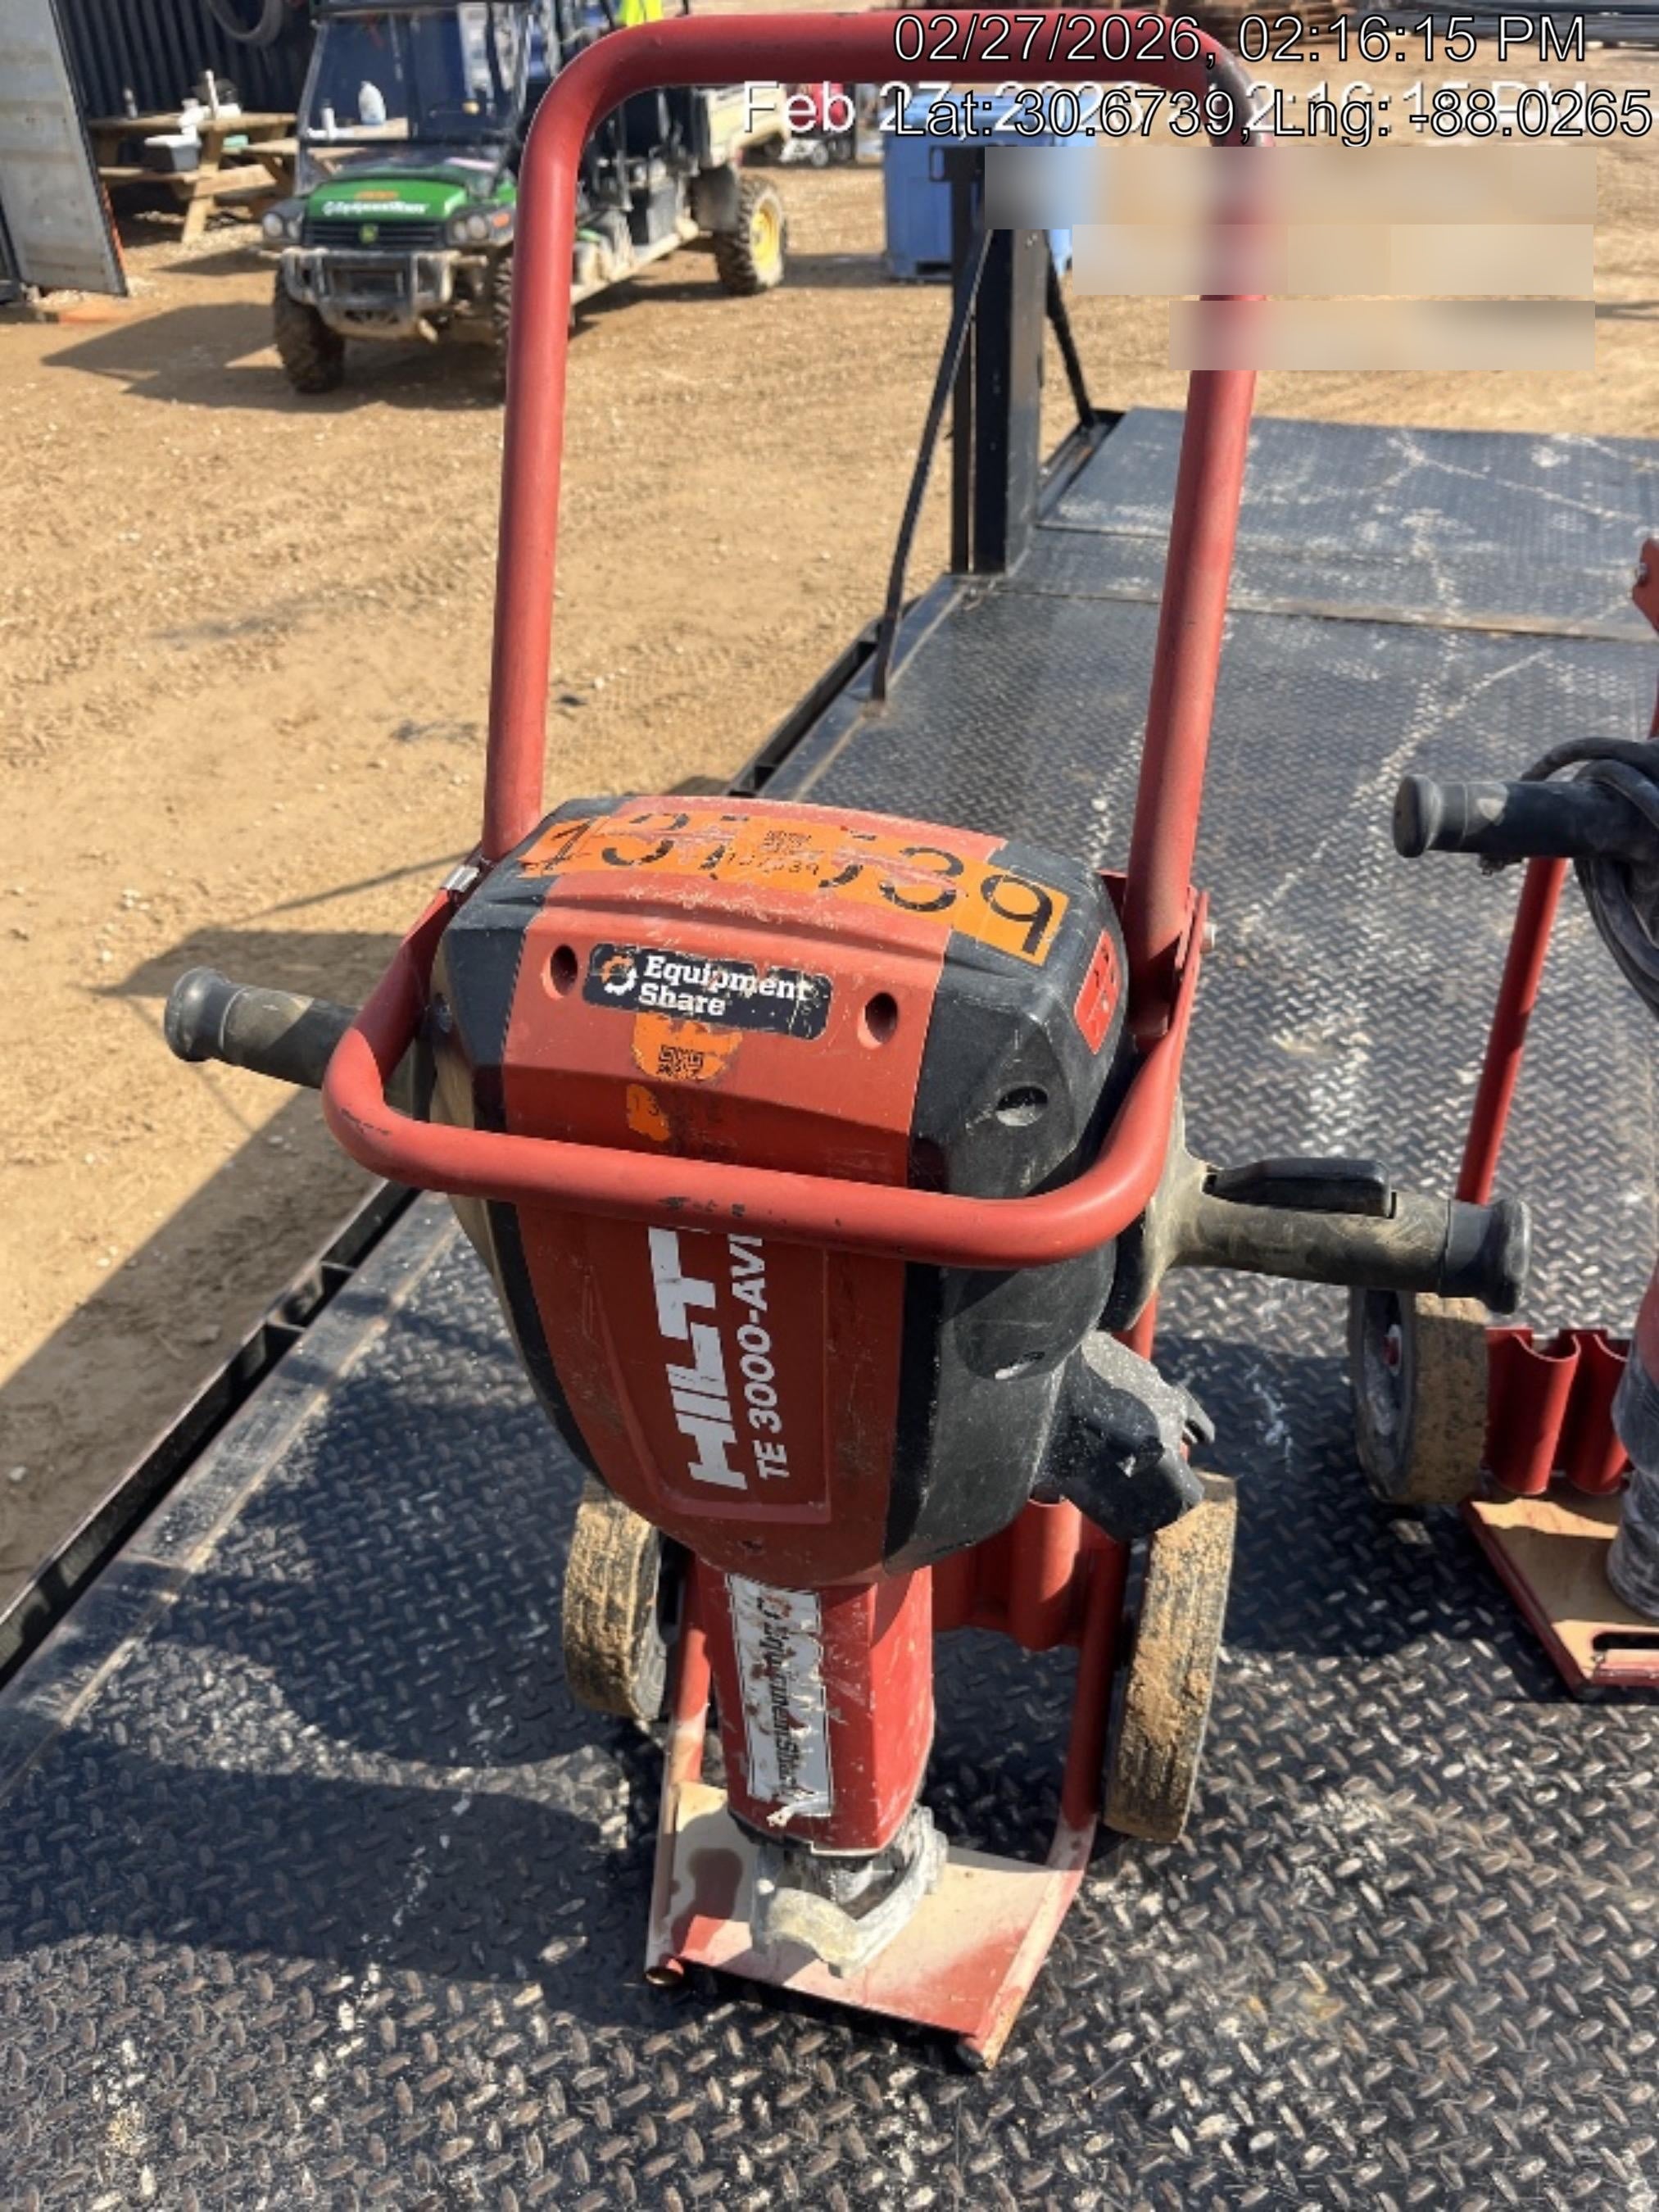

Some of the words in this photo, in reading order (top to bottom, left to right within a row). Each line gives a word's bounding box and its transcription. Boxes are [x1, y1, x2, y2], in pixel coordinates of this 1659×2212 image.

[643, 954, 814, 1000] Equipment
[637, 982, 727, 1017] Share
[648, 1226, 747, 1490] HILT
[753, 1439, 791, 1480] TE
